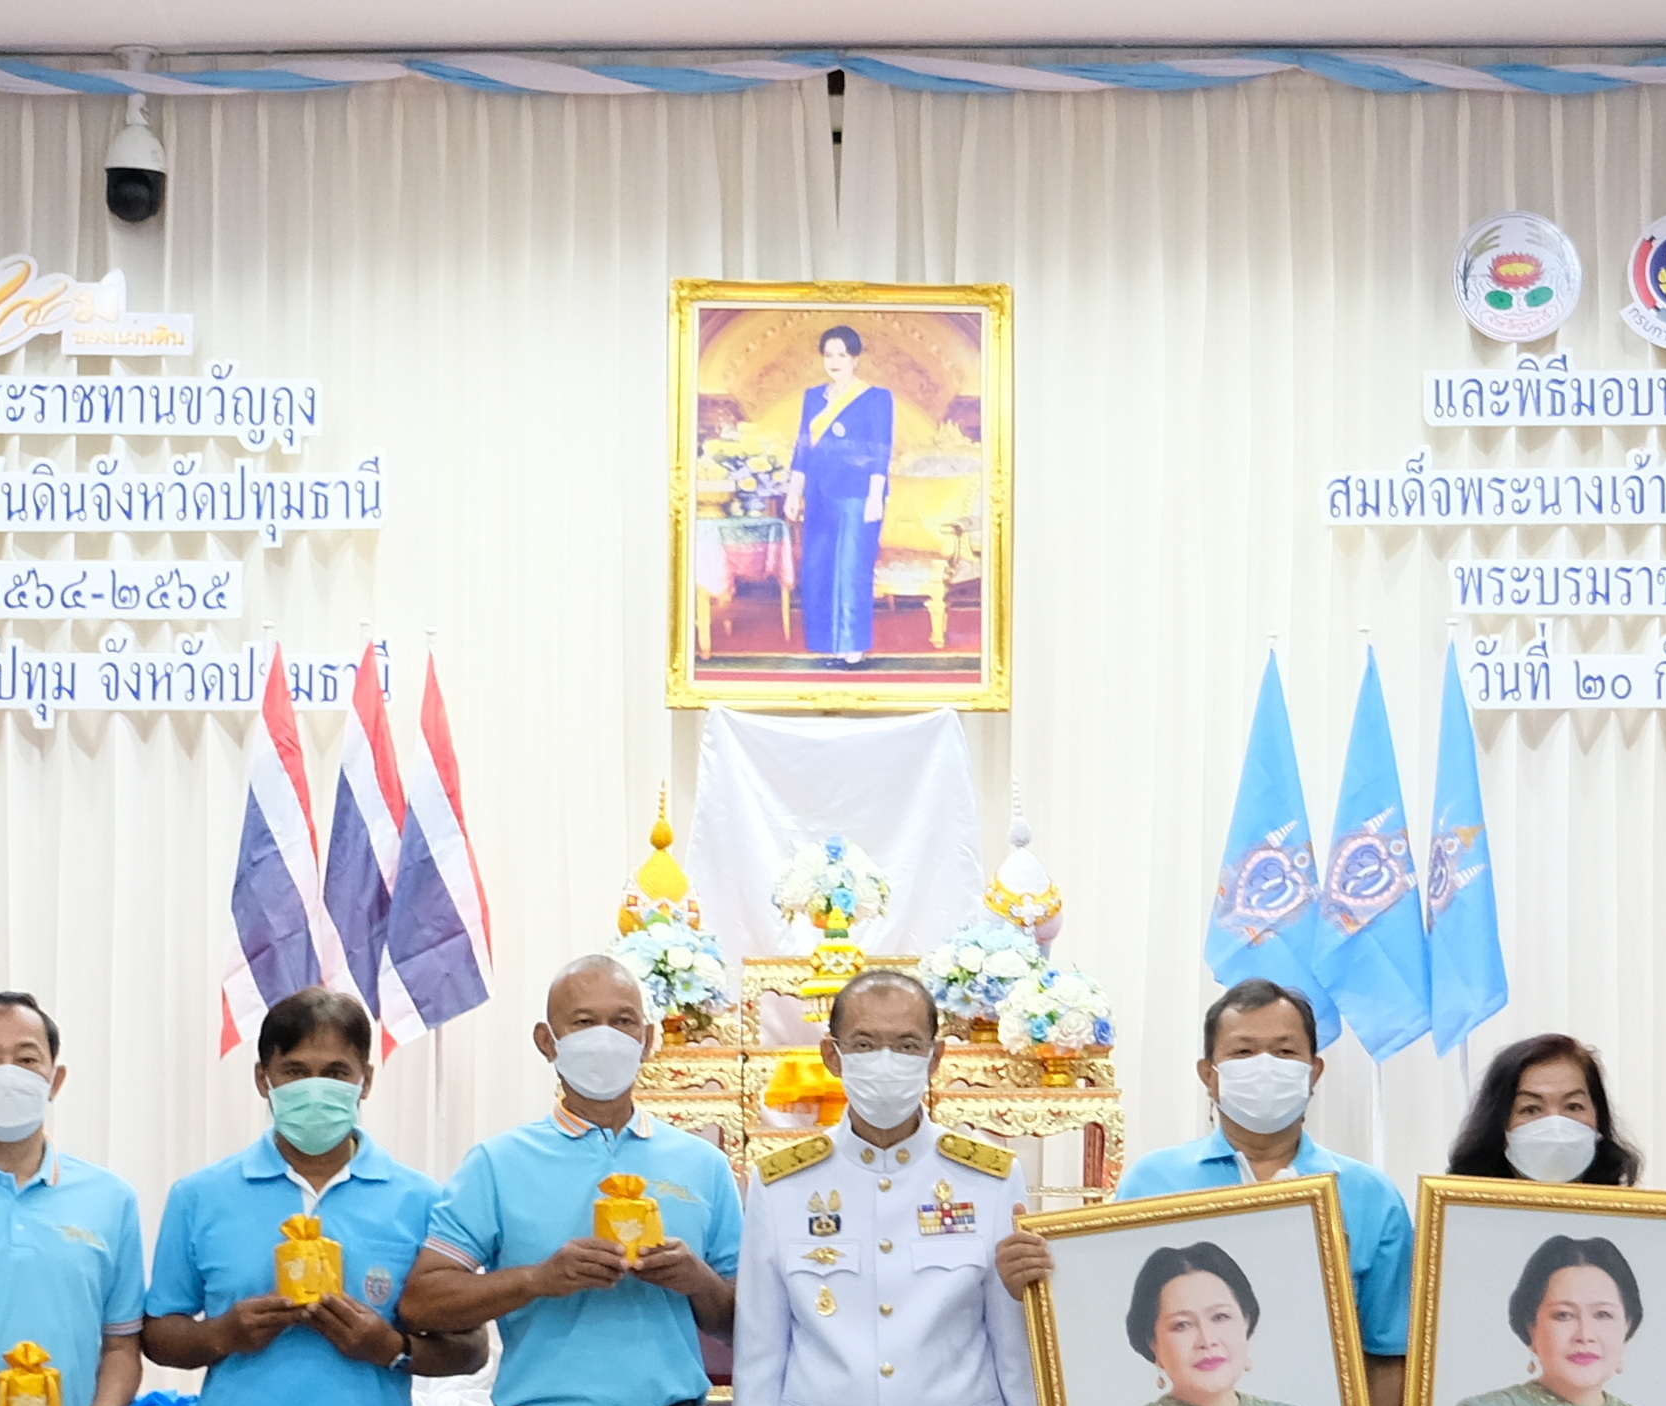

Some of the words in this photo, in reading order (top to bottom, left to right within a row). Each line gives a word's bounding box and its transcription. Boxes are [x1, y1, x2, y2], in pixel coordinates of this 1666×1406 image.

[1469, 623, 1550, 702] วันที่
[1574, 660, 1633, 700] ๒๐
